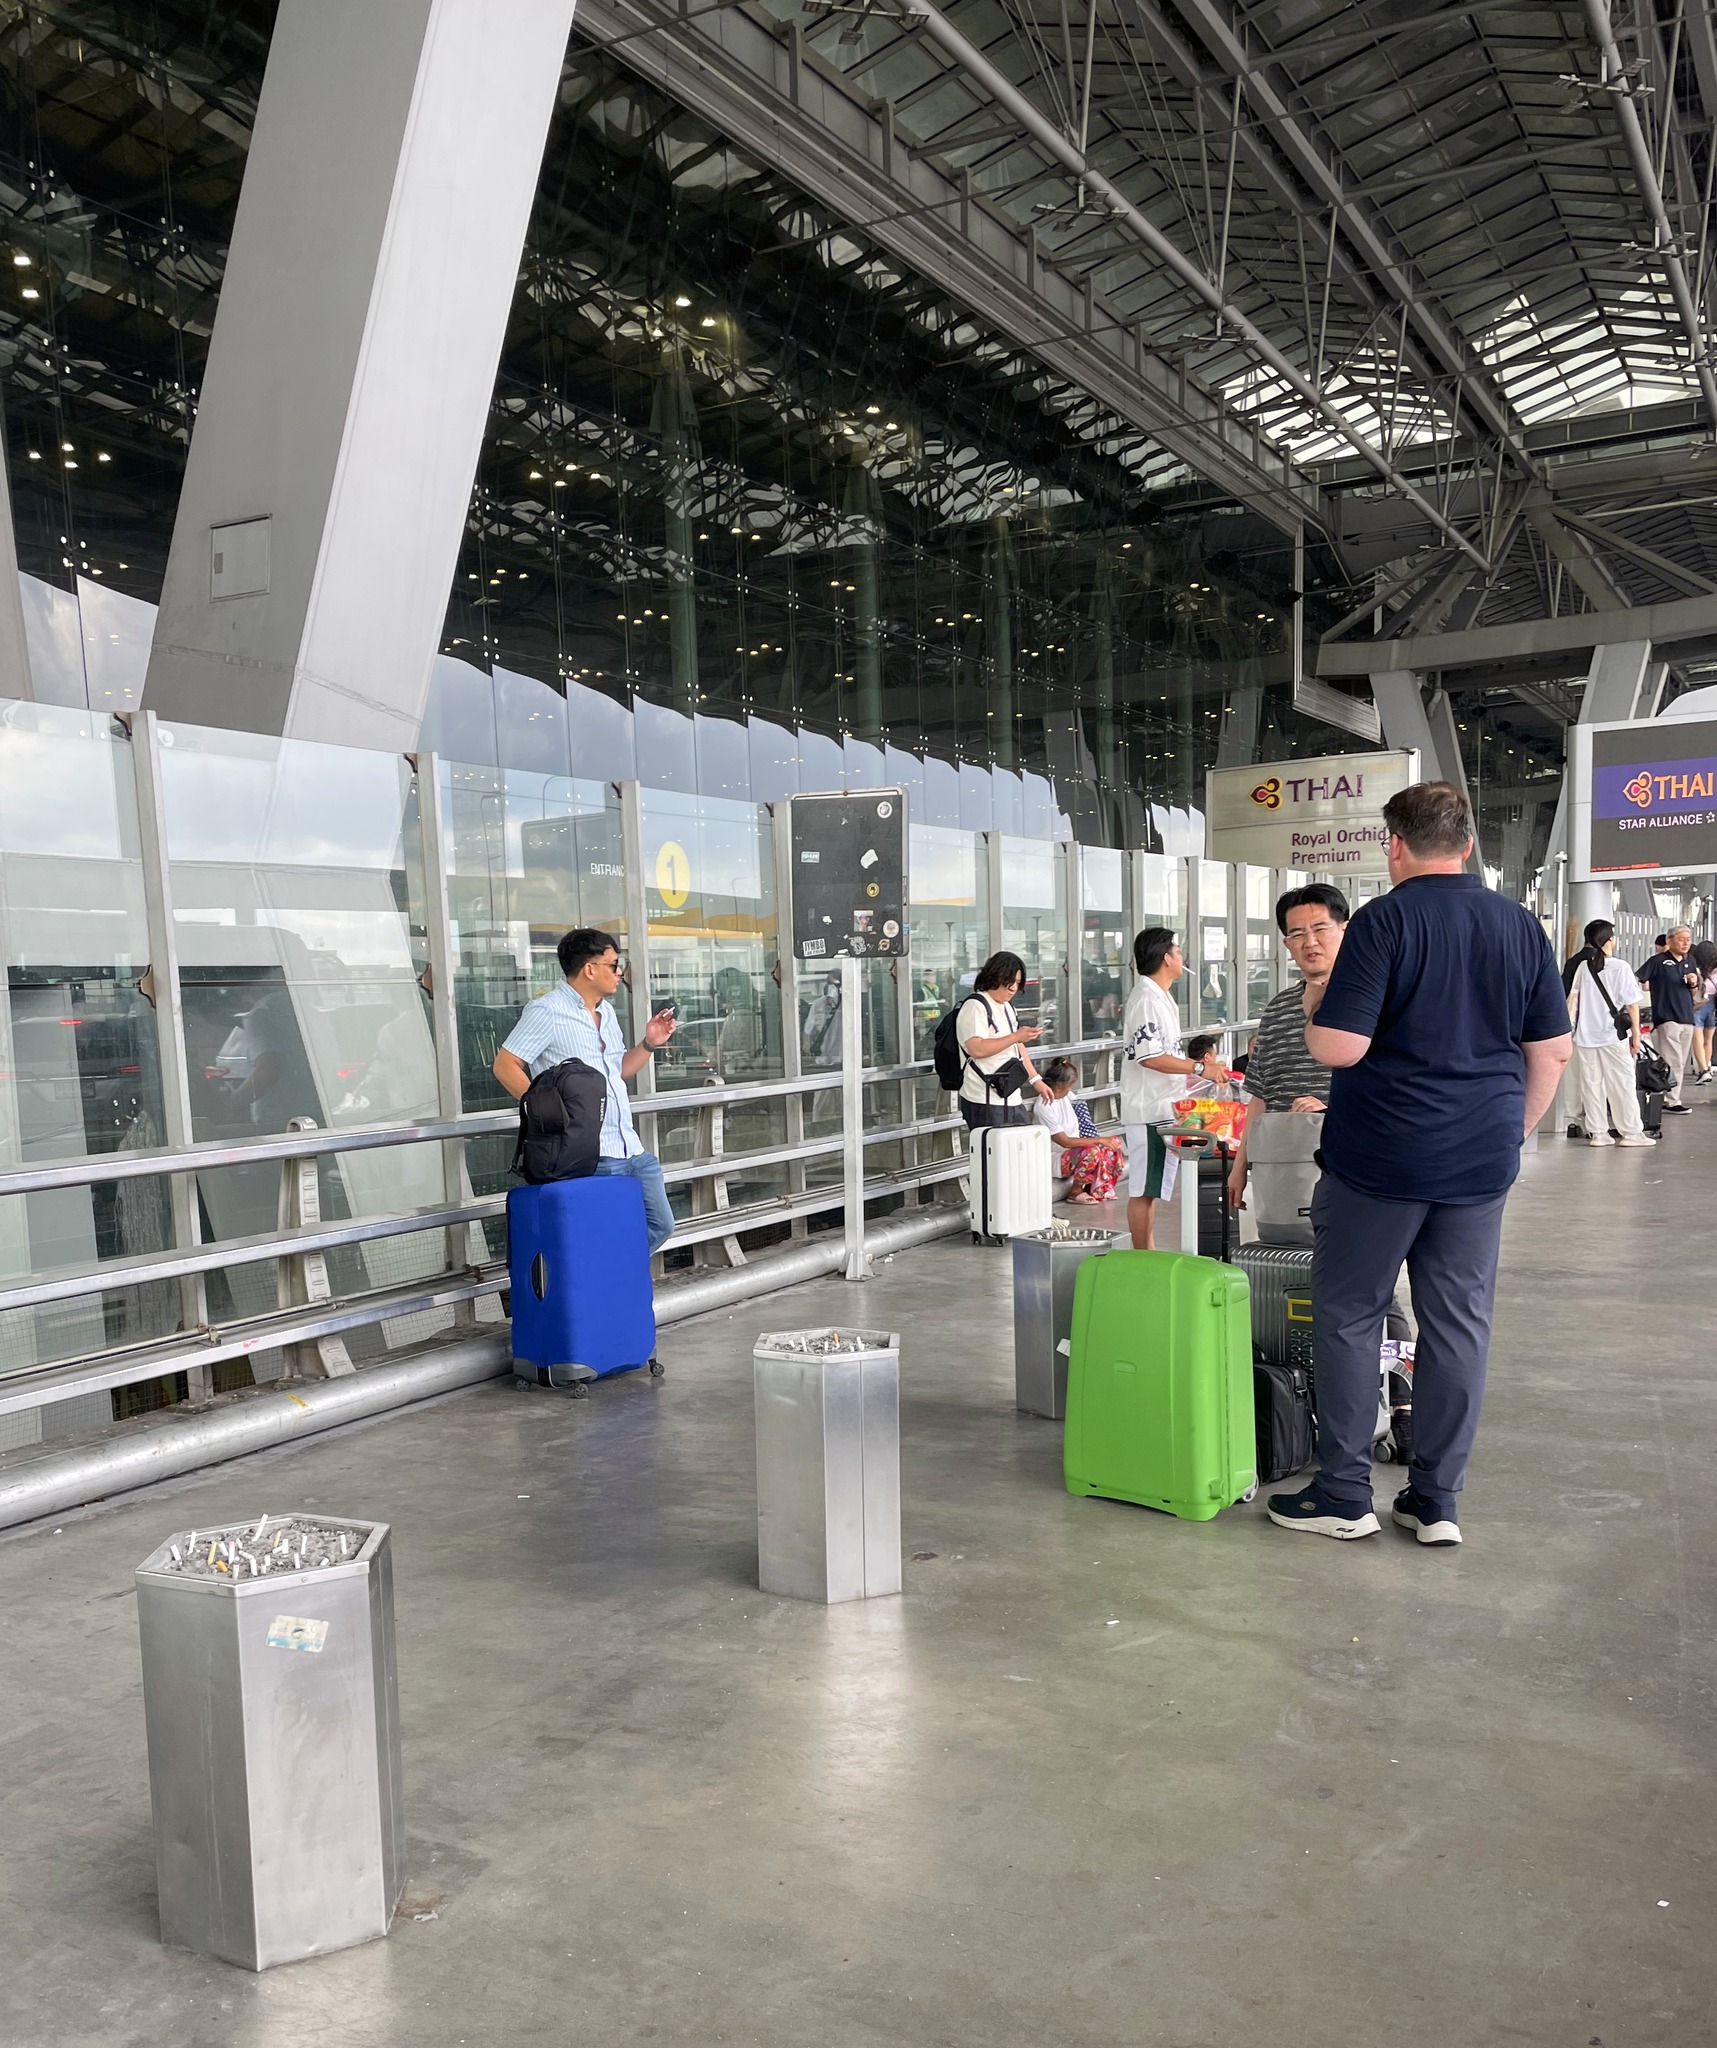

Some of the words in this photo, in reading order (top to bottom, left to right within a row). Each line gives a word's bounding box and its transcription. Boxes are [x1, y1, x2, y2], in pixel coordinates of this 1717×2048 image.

[1286, 774, 1364, 802] THAI
[1654, 772, 1714, 800] THAI
[1618, 818, 1646, 830] STAR
[1649, 813, 1703, 827] ALLIANCE
[1292, 830, 1331, 847] Royal
[1337, 827, 1387, 843] Orchid
[1292, 848, 1361, 865] Premium
[590, 862, 625, 877] ENTRANC
